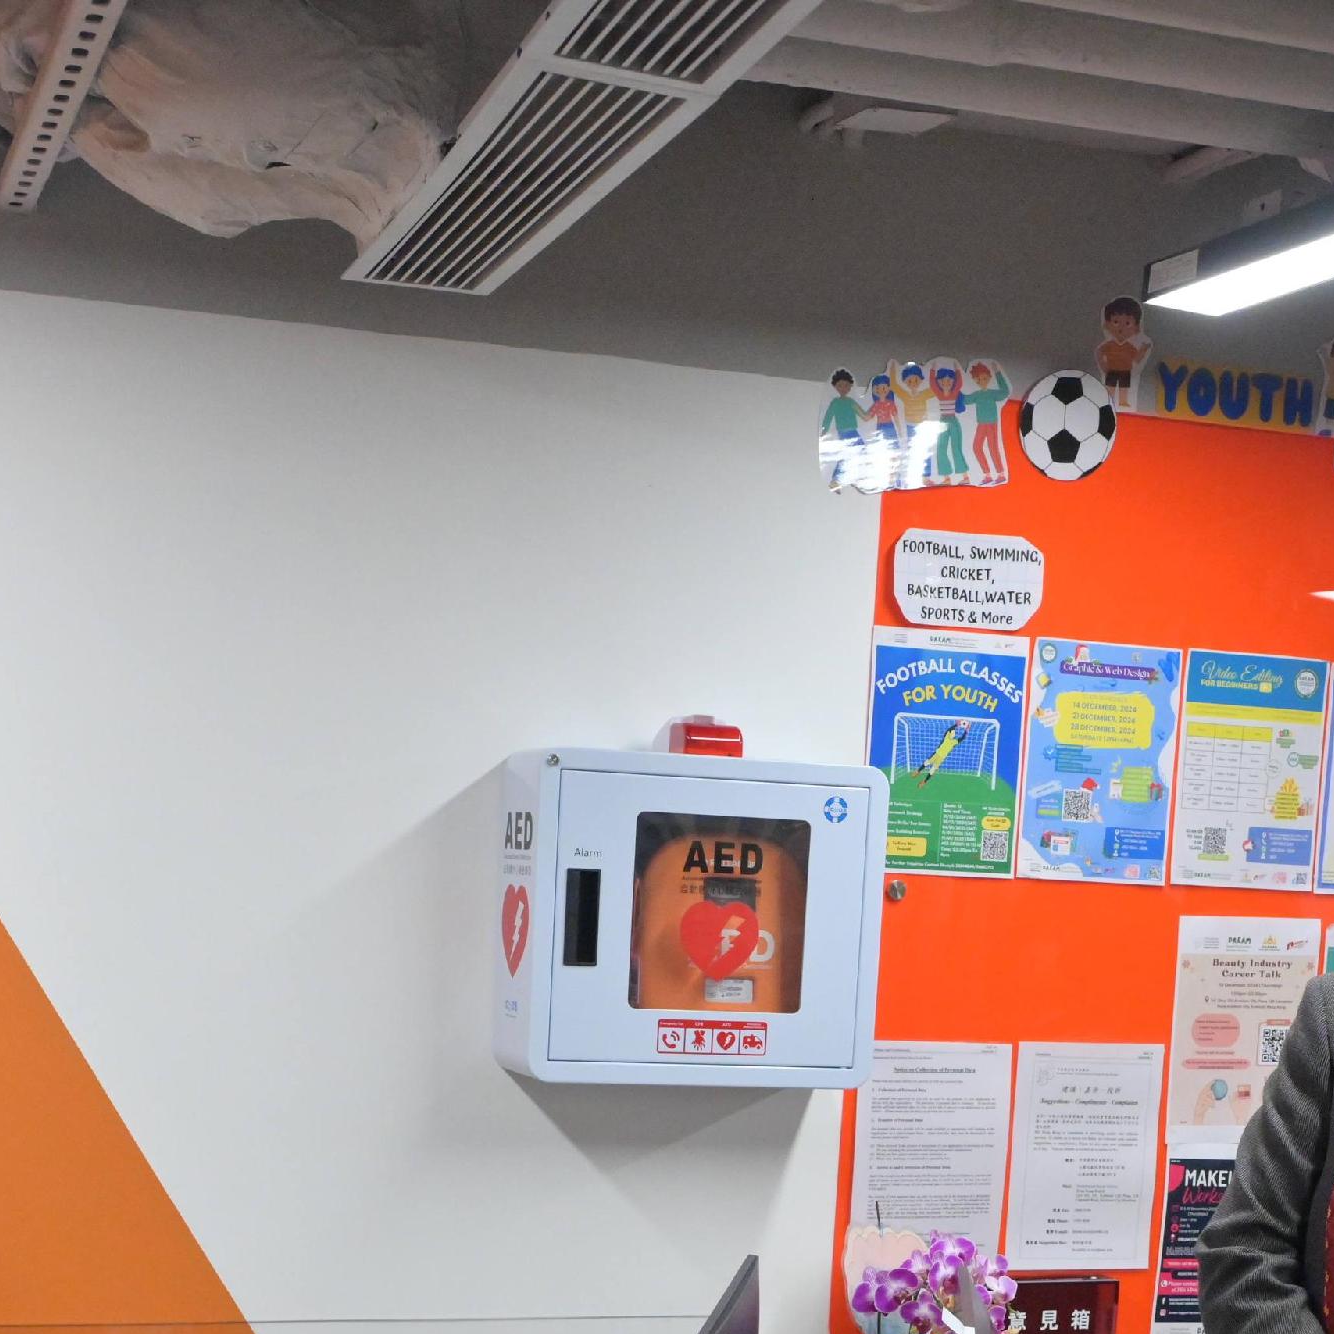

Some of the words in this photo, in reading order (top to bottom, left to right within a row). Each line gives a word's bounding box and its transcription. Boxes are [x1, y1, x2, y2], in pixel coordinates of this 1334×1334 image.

[1156, 360, 1314, 429] YOUTH
[903, 540, 965, 561] FOOTBALL,
[969, 546, 1042, 566] SWIMMING,
[941, 565, 995, 585] CRICKET,
[920, 606, 965, 623] SPORTS
[967, 611, 977, 624] &
[981, 611, 1013, 625] More
[875, 658, 956, 695] FOOTBALL
[959, 660, 1024, 705] CLASSES
[1123, 667, 1151, 680] Design
[1201, 661, 1238, 681] Video
[902, 685, 937, 707] FOR
[940, 684, 999, 713] YOUTH
[504, 812, 534, 850] AED
[574, 848, 603, 857] Alarm
[683, 840, 764, 875] AED
[1212, 958, 1247, 969] Beauty
[1250, 959, 1293, 970] Industry
[1259, 971, 1282, 979] Talk
[1008, 1309, 1091, 1331] 意見箱
